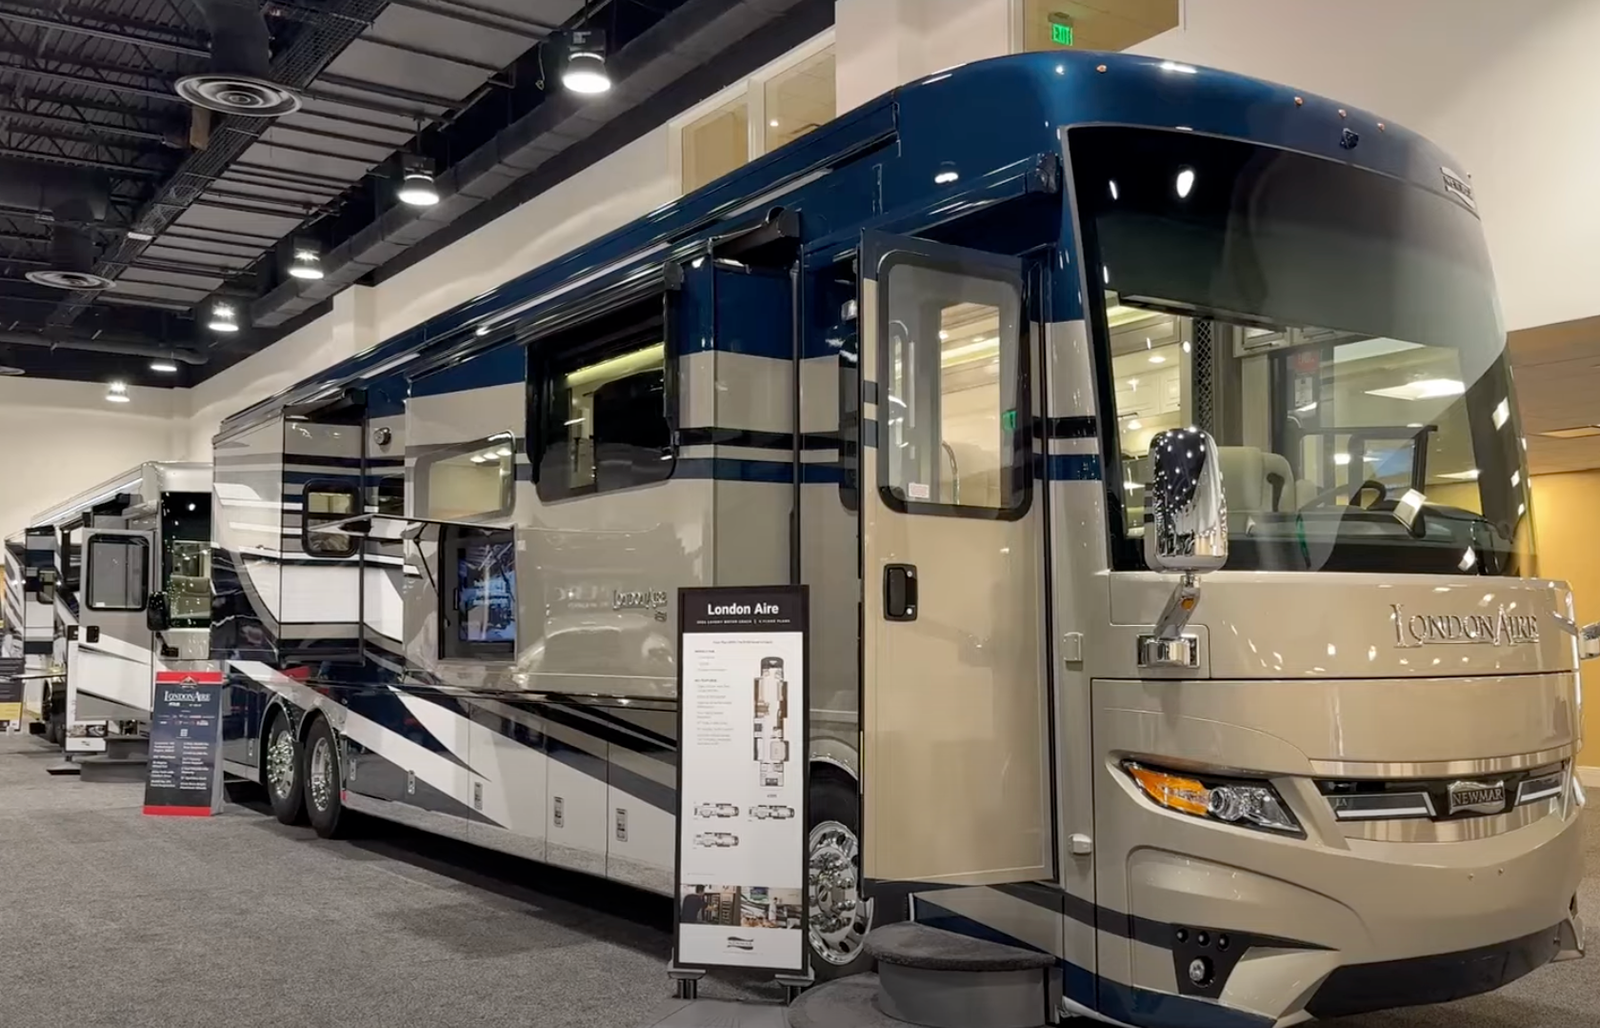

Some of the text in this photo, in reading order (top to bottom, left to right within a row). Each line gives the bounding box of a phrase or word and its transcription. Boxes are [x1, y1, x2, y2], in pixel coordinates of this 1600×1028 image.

[707, 602, 779, 615] London Aire
[1453, 788, 1504, 806] NEWMAR
